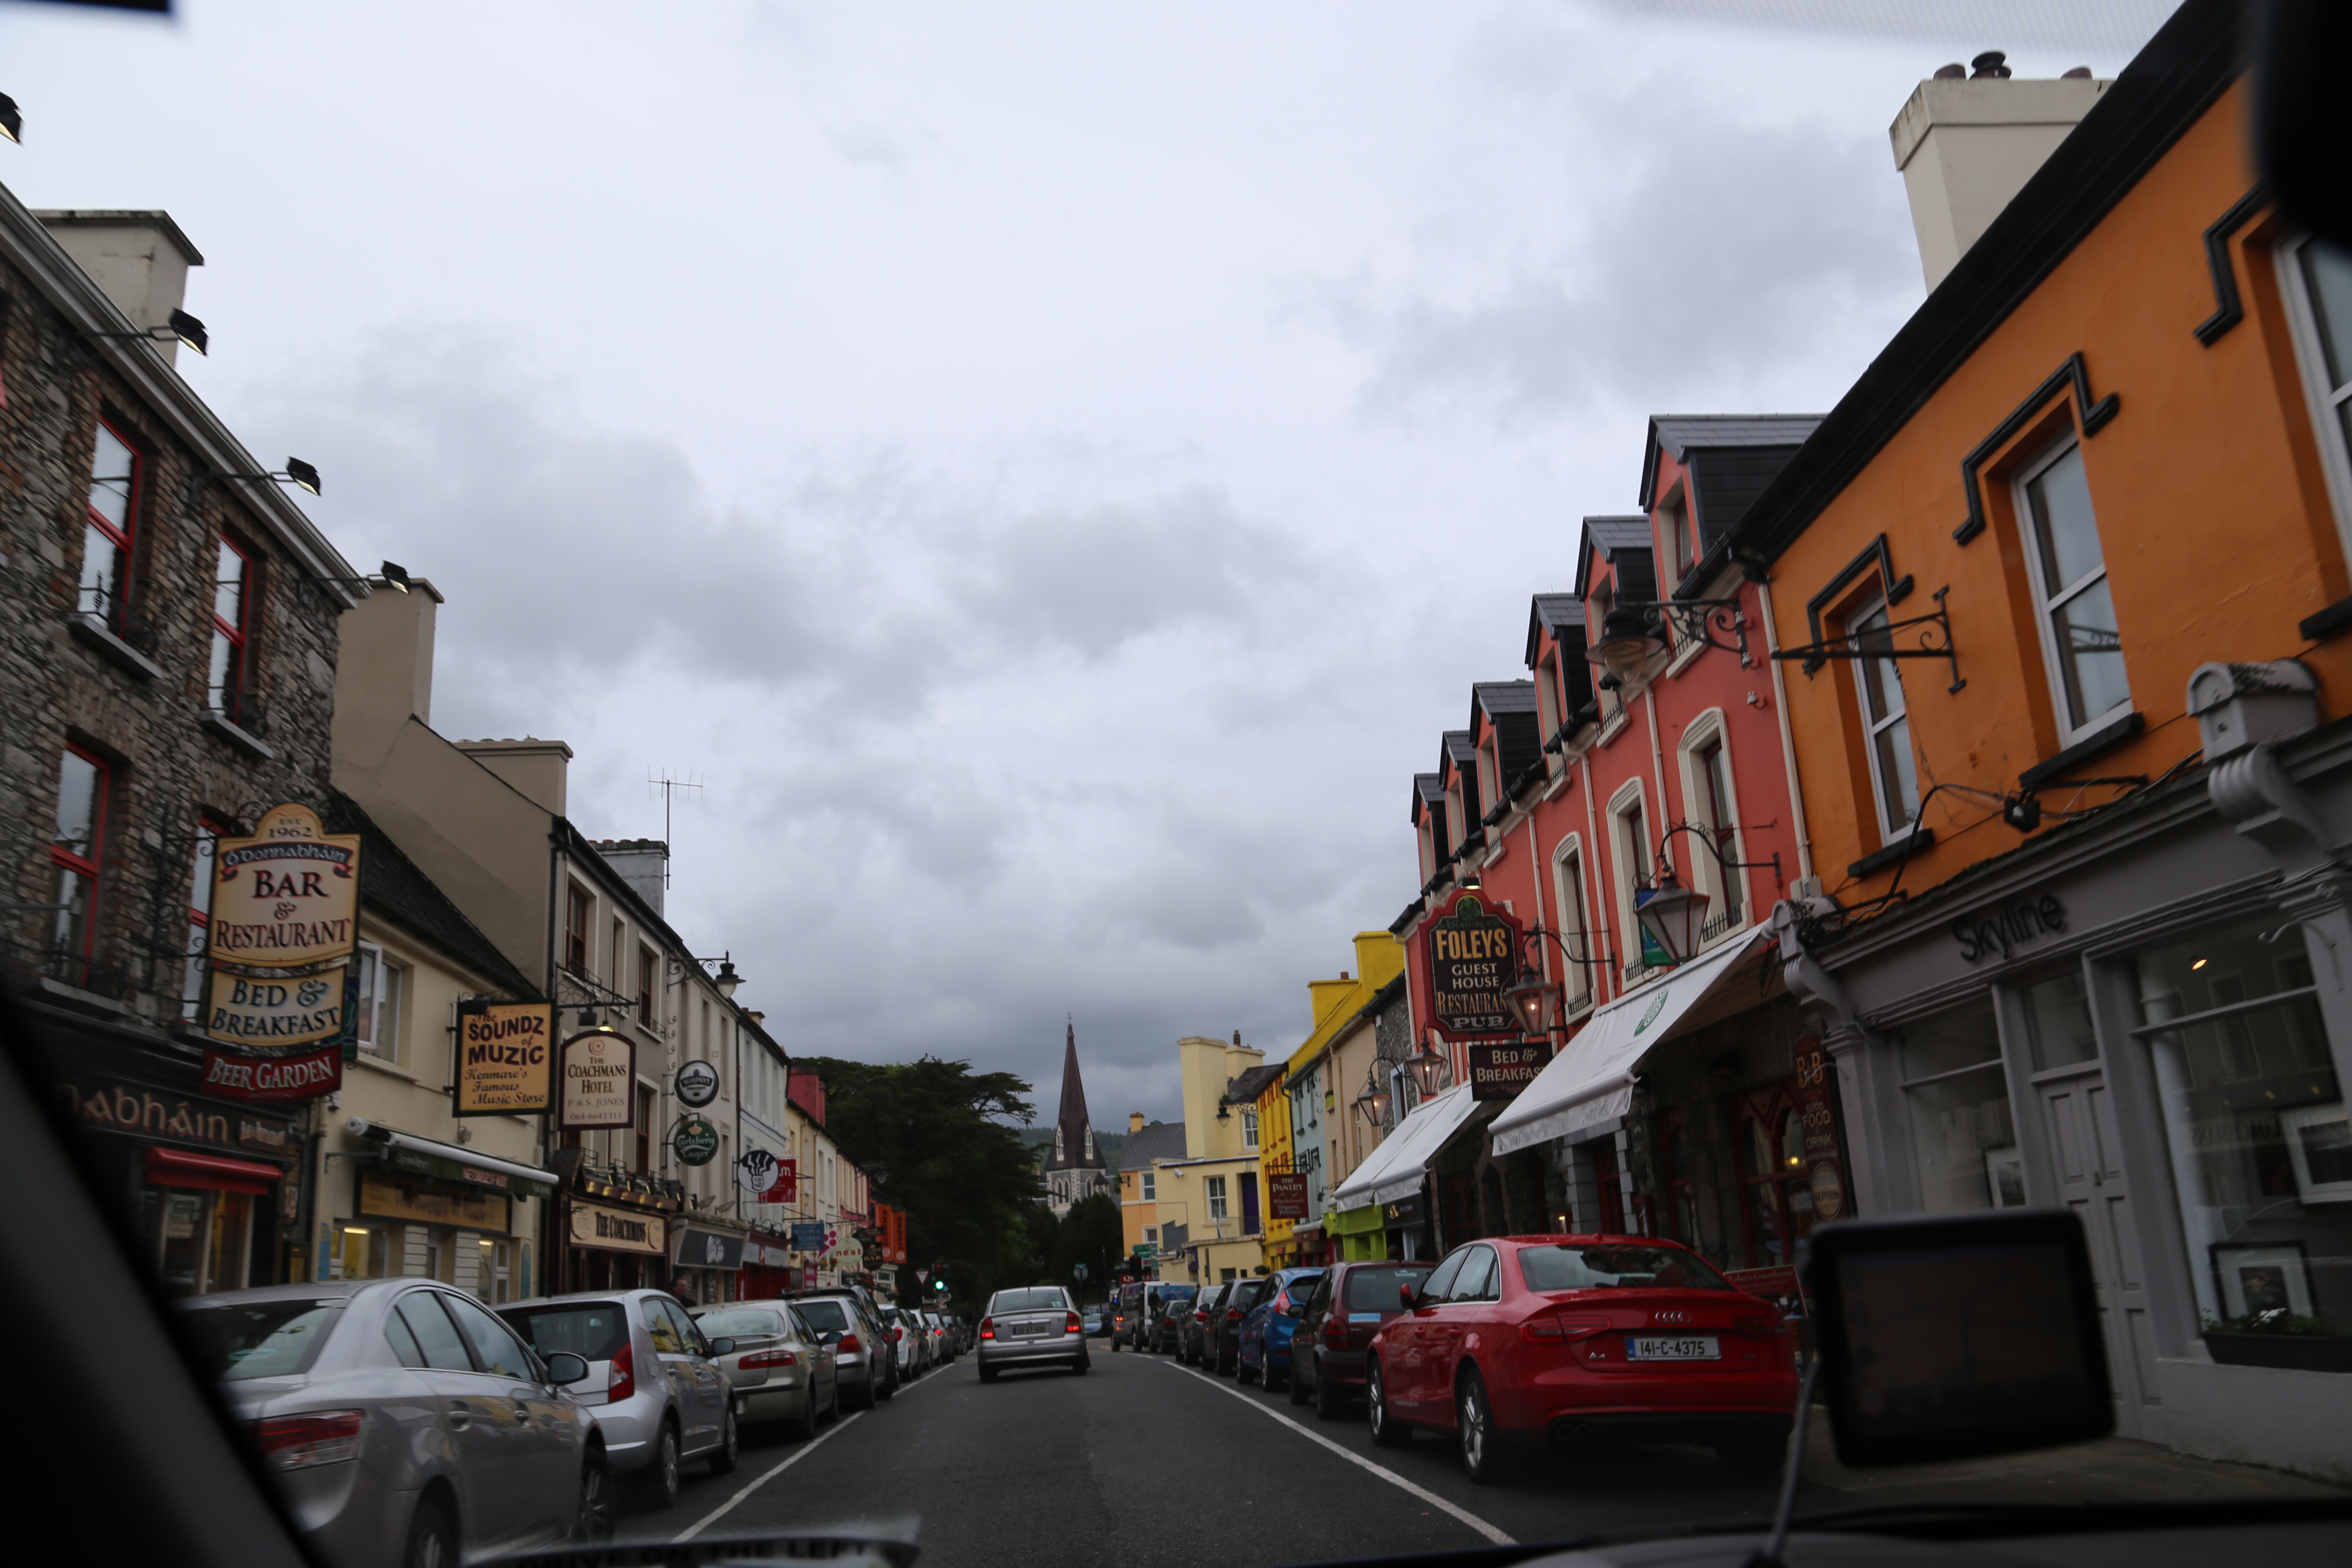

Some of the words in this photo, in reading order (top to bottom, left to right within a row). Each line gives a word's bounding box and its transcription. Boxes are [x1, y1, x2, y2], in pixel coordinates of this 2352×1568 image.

[268, 827, 312, 838] 1962
[252, 870, 330, 899] BAR
[273, 902, 297, 920] &
[214, 918, 352, 952] RESTAURANT
[1952, 894, 2064, 961] Skyline
[1436, 928, 1507, 961] FOLEYS
[1452, 963, 1497, 976] GUEST
[1452, 976, 1500, 989] HOUSE
[228, 978, 288, 1007] BED
[297, 979, 333, 1008] &
[208, 1006, 341, 1038] BREAKFAST
[468, 1015, 545, 1041] SOUNDZ
[1452, 1015, 1504, 1029] PUB
[521, 1034, 534, 1048] of
[468, 1044, 545, 1066] MUZIC
[588, 1057, 604, 1065] THE
[1492, 1050, 1518, 1065] BED
[1522, 1048, 1537, 1063] &
[205, 1057, 257, 1092] BEER
[256, 1055, 335, 1090] GARDEN
[464, 1067, 528, 1081] Kenmare's
[567, 1064, 627, 1078] COACHMANS
[1476, 1066, 1546, 1083] BREAKFAS
[472, 1081, 520, 1093] Famous
[581, 1079, 614, 1094] HOTEL
[472, 1094, 511, 1105] Music
[514, 1092, 545, 1103] Store
[596, 1098, 625, 1108] JONES
[1803, 1110, 1831, 1129] FOOD
[676, 1133, 715, 1149] Carlsberg
[1806, 1134, 1833, 1150] DRINK
[1272, 1183, 1303, 1193] PANTRY
[836, 1248, 861, 1256] nest
[1640, 1340, 1705, 1355] 141-C-4375
